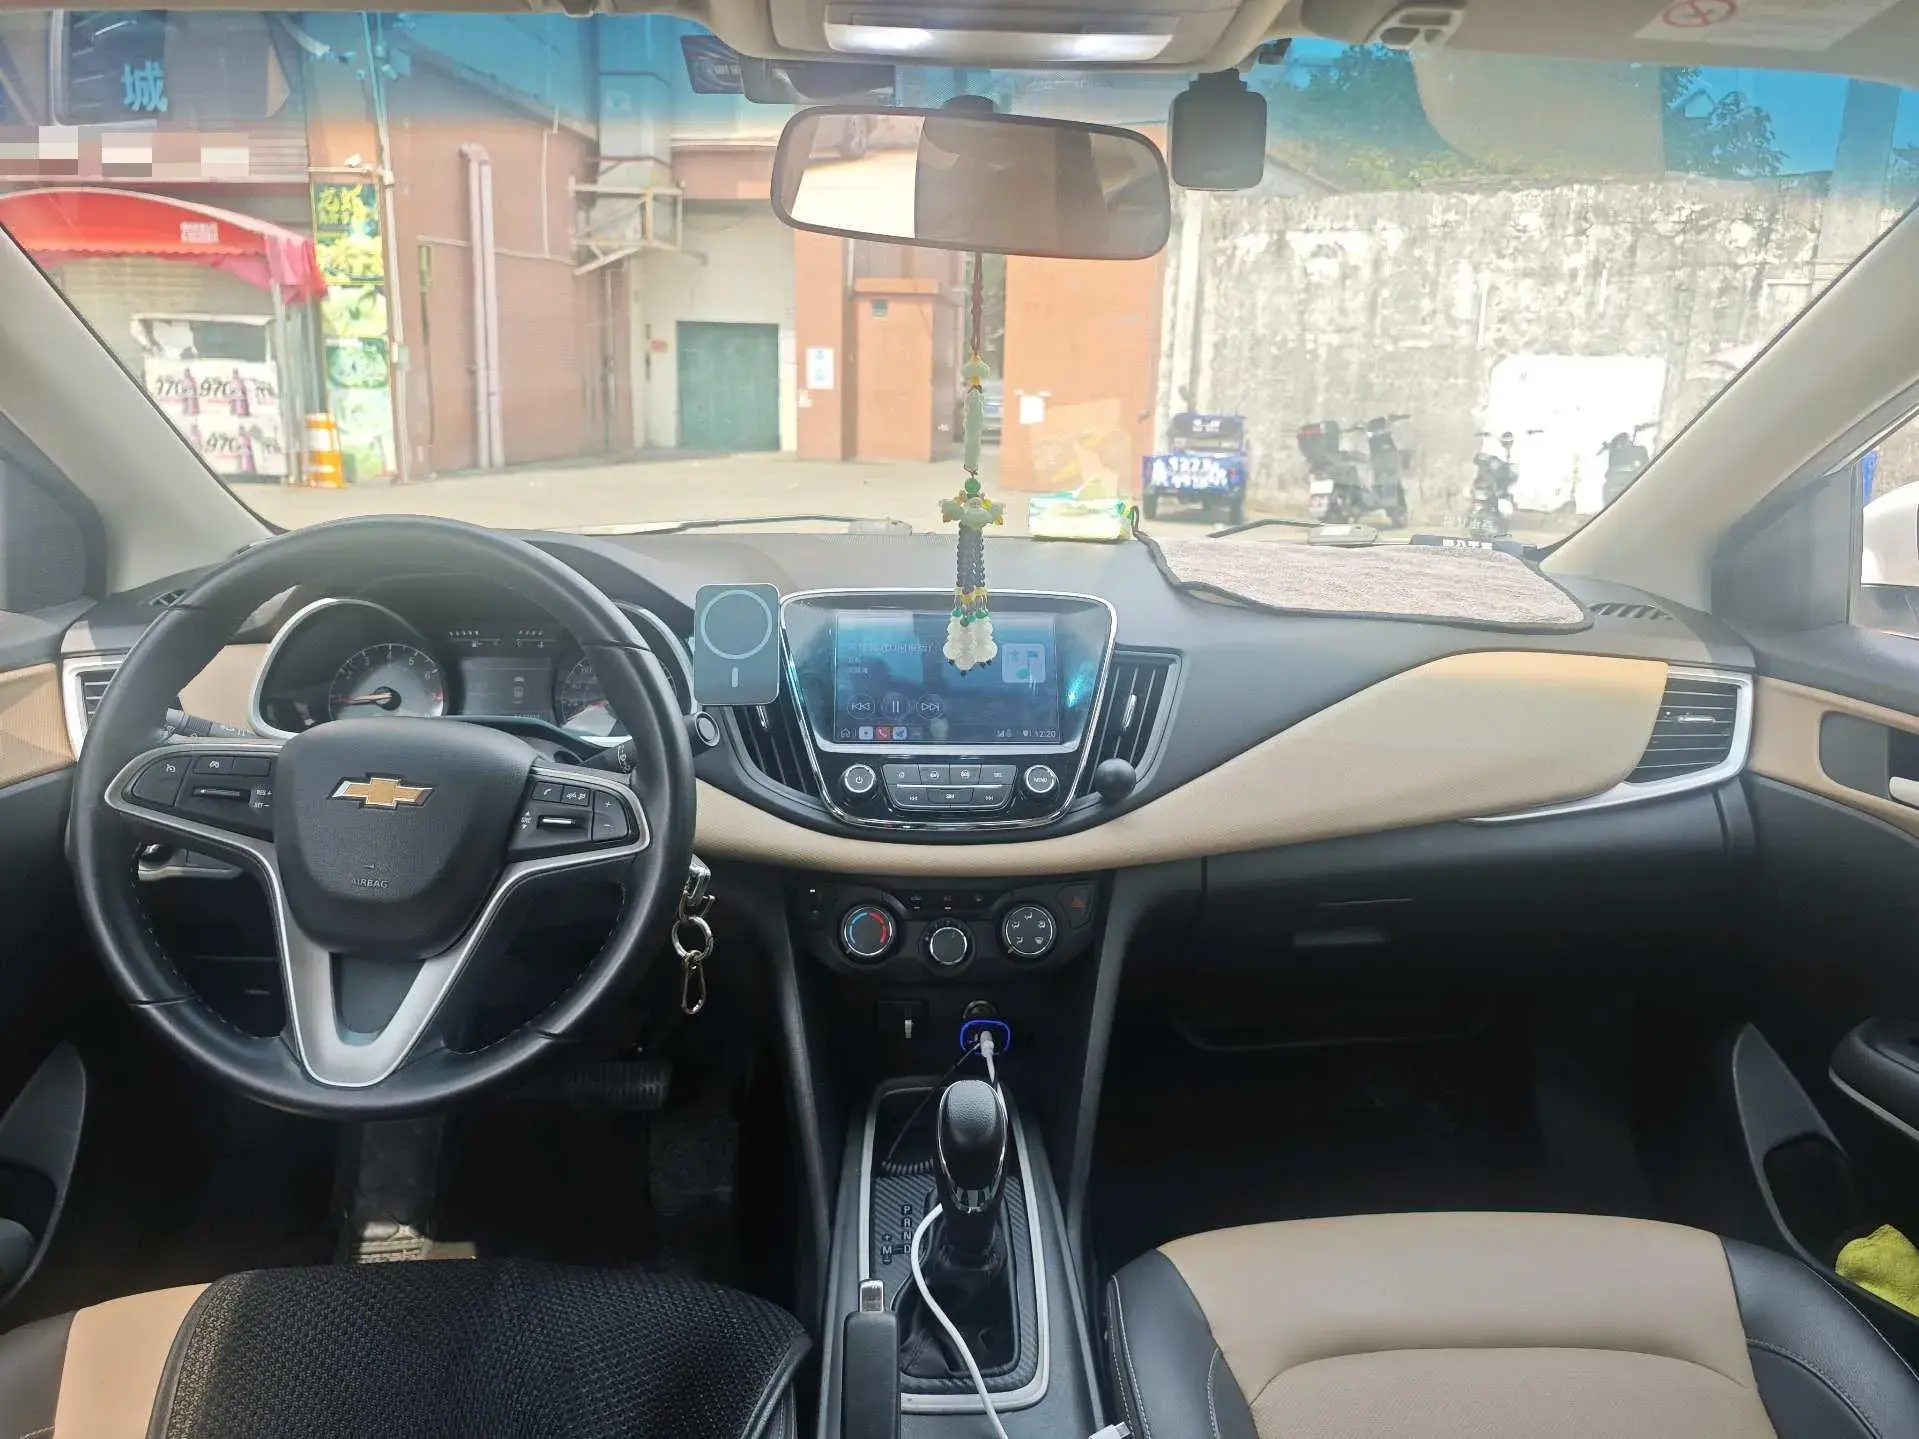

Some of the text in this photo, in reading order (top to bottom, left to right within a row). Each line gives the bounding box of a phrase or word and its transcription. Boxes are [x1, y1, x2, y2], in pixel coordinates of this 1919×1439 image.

[121, 59, 168, 112] 城
[351, 878, 390, 889] AIRBAG
[903, 1205, 911, 1214] P
[903, 1231, 911, 1240] N
[882, 1246, 892, 1255] M
[903, 1244, 911, 1253] D
